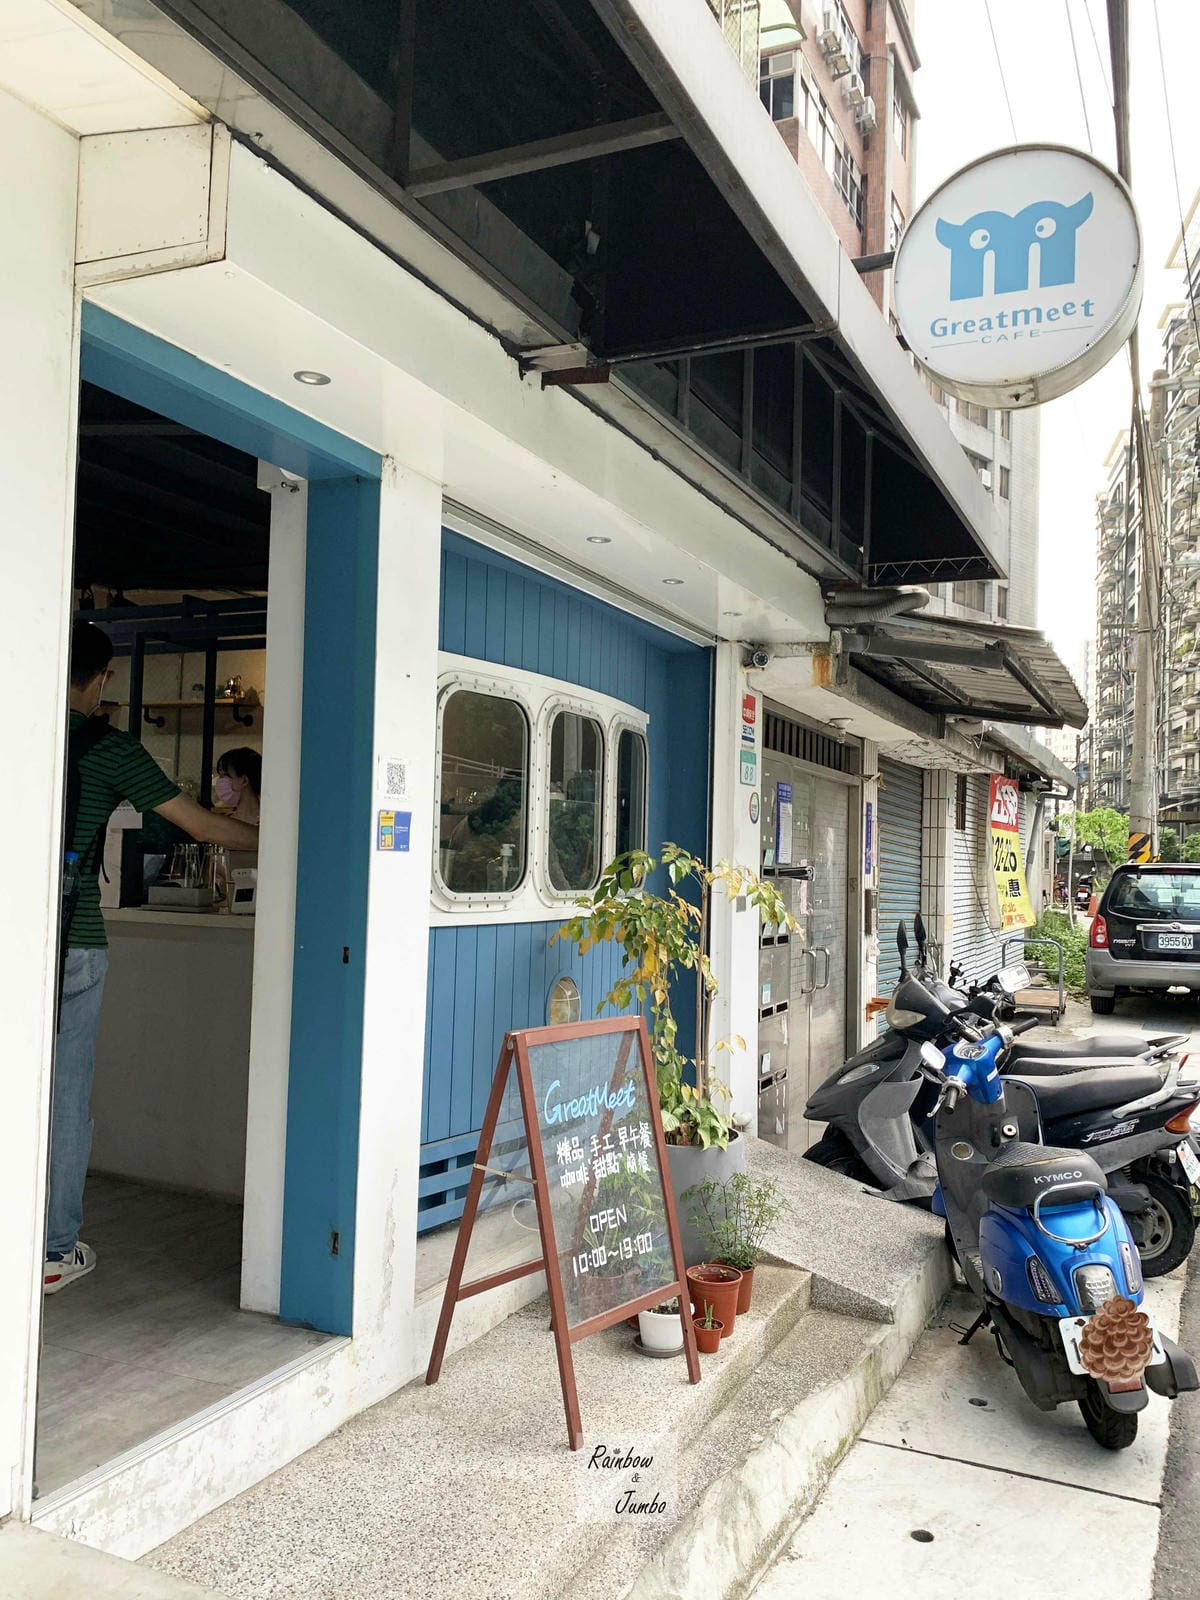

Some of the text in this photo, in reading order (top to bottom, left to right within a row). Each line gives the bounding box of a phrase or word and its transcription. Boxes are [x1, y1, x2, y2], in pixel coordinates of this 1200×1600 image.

[930, 299, 1095, 337] Greatmeet
[981, 328, 1041, 344] CAFE
[544, 1079, 635, 1124] GreatMeet
[557, 1136, 584, 1165] 精品
[590, 1133, 614, 1157] 手工
[560, 1162, 589, 1188] 咖啡
[1033, 1170, 1083, 1184] KYMCO
[590, 1204, 628, 1234] OPEN
